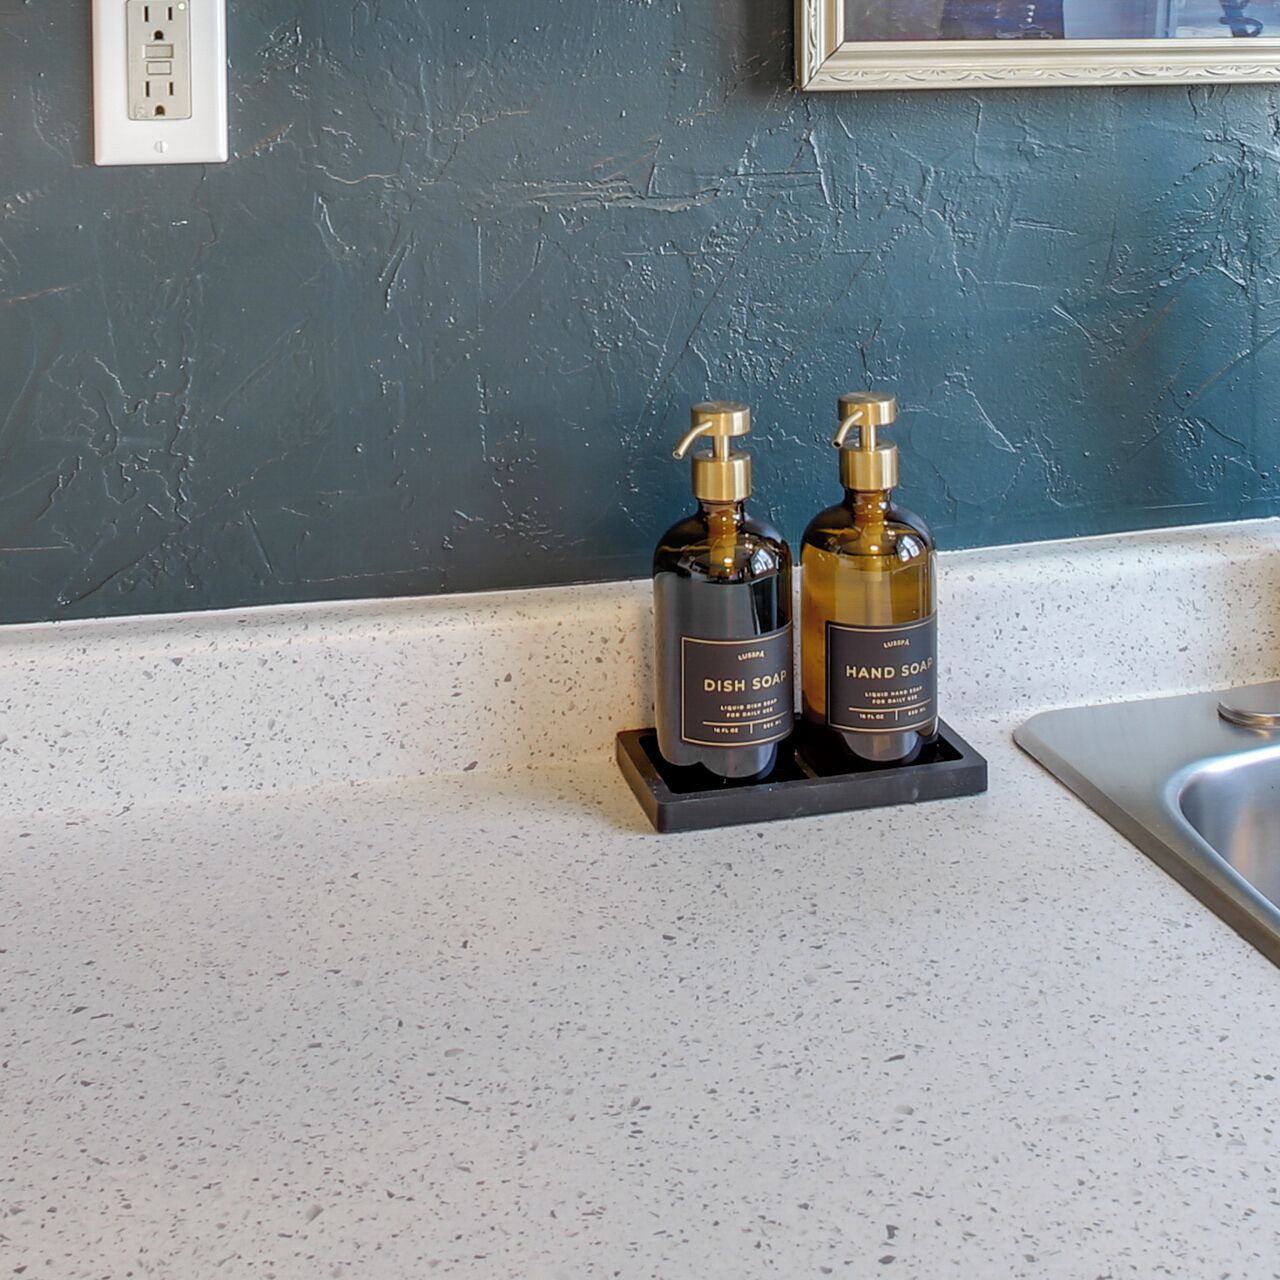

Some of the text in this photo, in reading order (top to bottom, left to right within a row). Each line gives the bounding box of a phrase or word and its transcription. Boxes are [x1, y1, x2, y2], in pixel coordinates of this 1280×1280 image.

[846, 657, 934, 679] HAND SOAP
[704, 670, 787, 692] DISH SOAP
[720, 704, 745, 712] LIQUID
[763, 698, 777, 707] SOAP
[763, 706, 774, 714] USE
